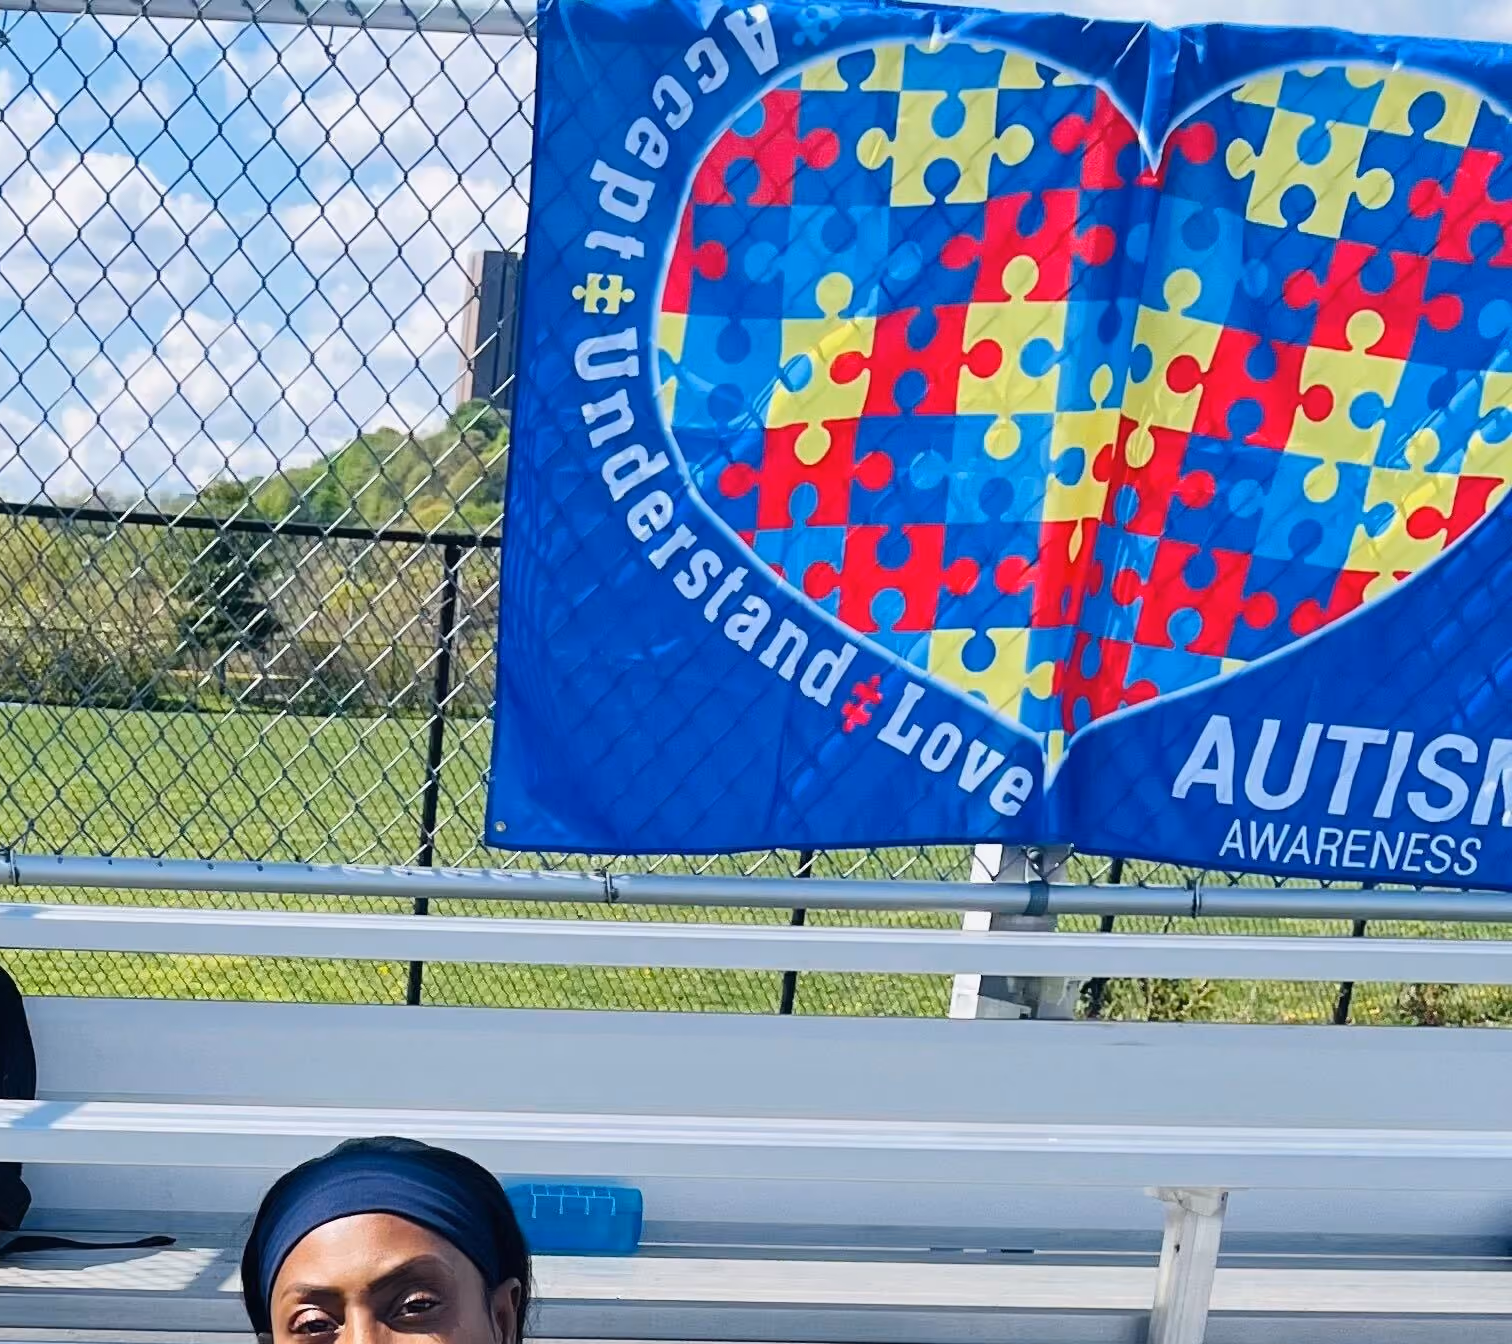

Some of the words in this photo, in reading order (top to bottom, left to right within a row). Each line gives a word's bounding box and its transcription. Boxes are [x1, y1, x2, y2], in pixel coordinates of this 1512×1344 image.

[585, 4, 779, 260] Accept
[574, 327, 859, 707] Understand
[877, 682, 1033, 816] Love
[1219, 819, 1482, 876] AWARENESS
